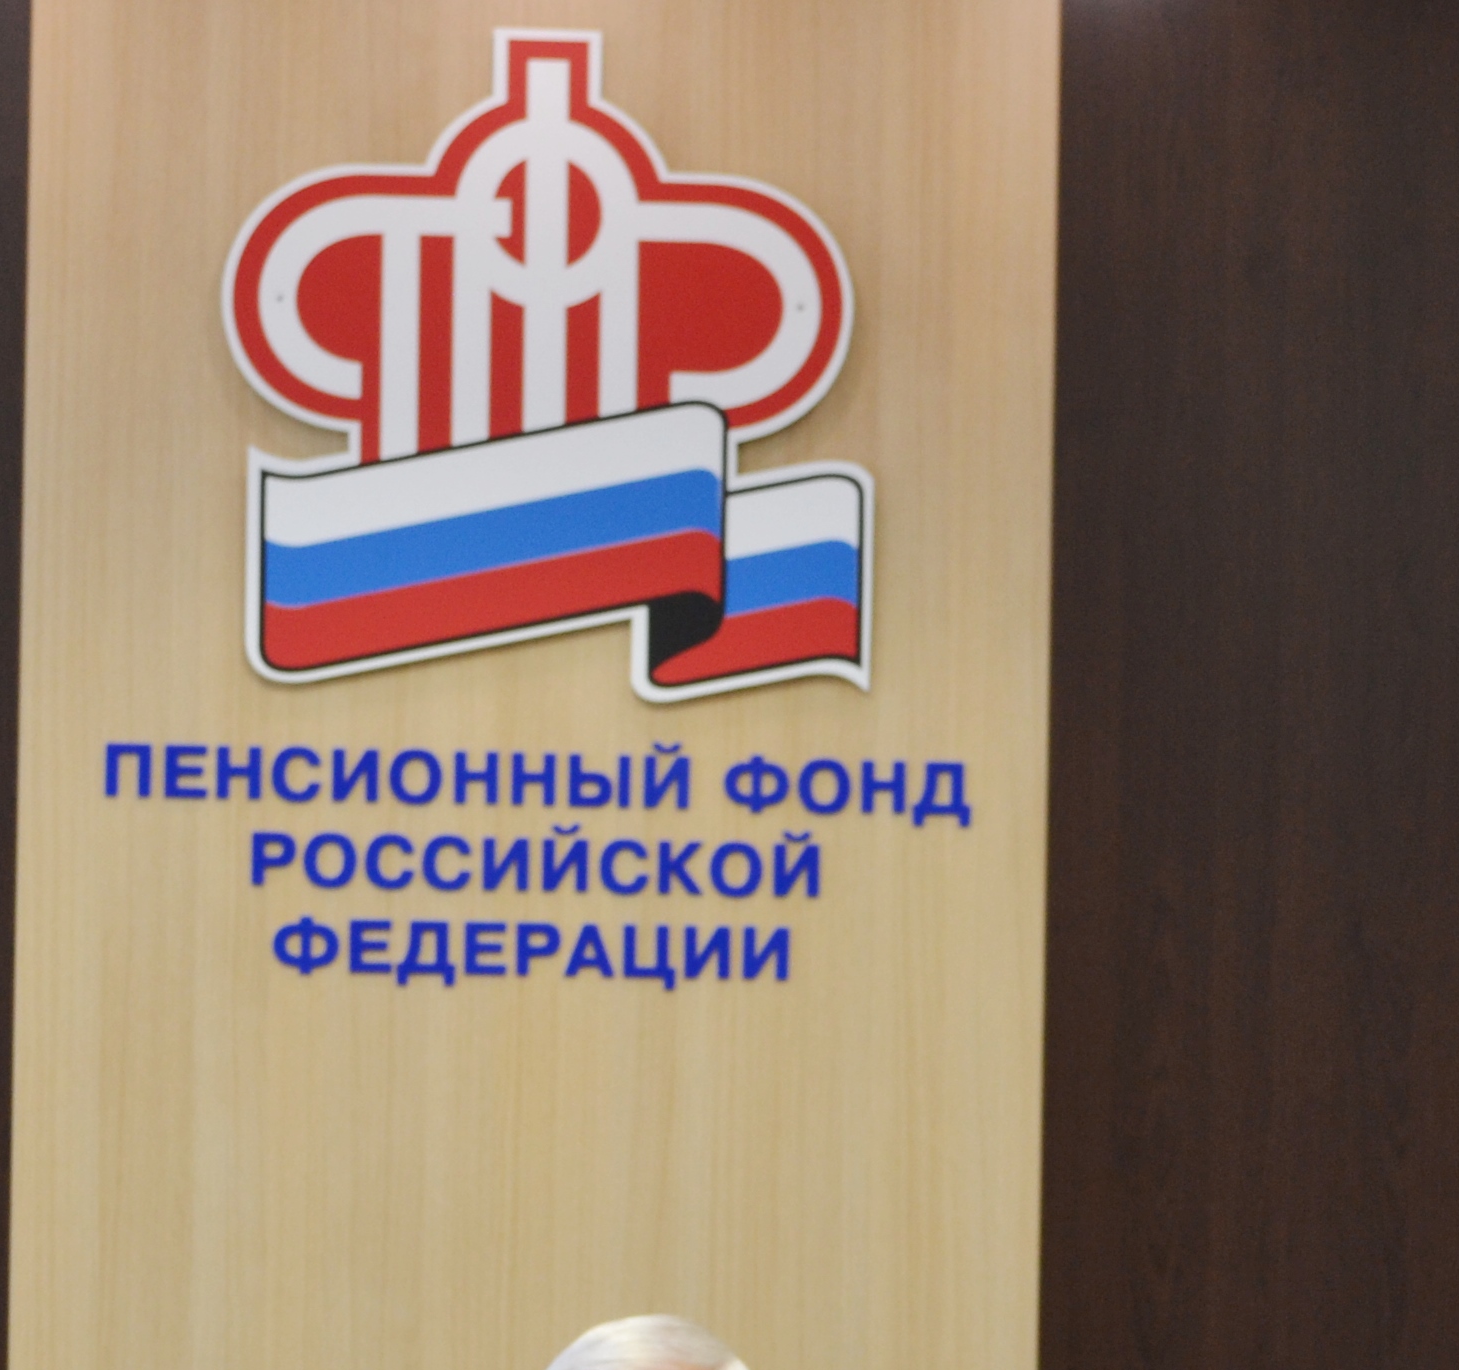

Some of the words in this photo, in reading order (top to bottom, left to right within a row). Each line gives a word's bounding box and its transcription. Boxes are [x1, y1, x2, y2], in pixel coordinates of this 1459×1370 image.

[104, 742, 691, 809] ПЕНСИОННЫЙ
[723, 754, 972, 828] ФОНД
[250, 823, 821, 898] РОССИЙСКОЙ
[272, 914, 791, 990] ФЕДЕРАЦИИ
